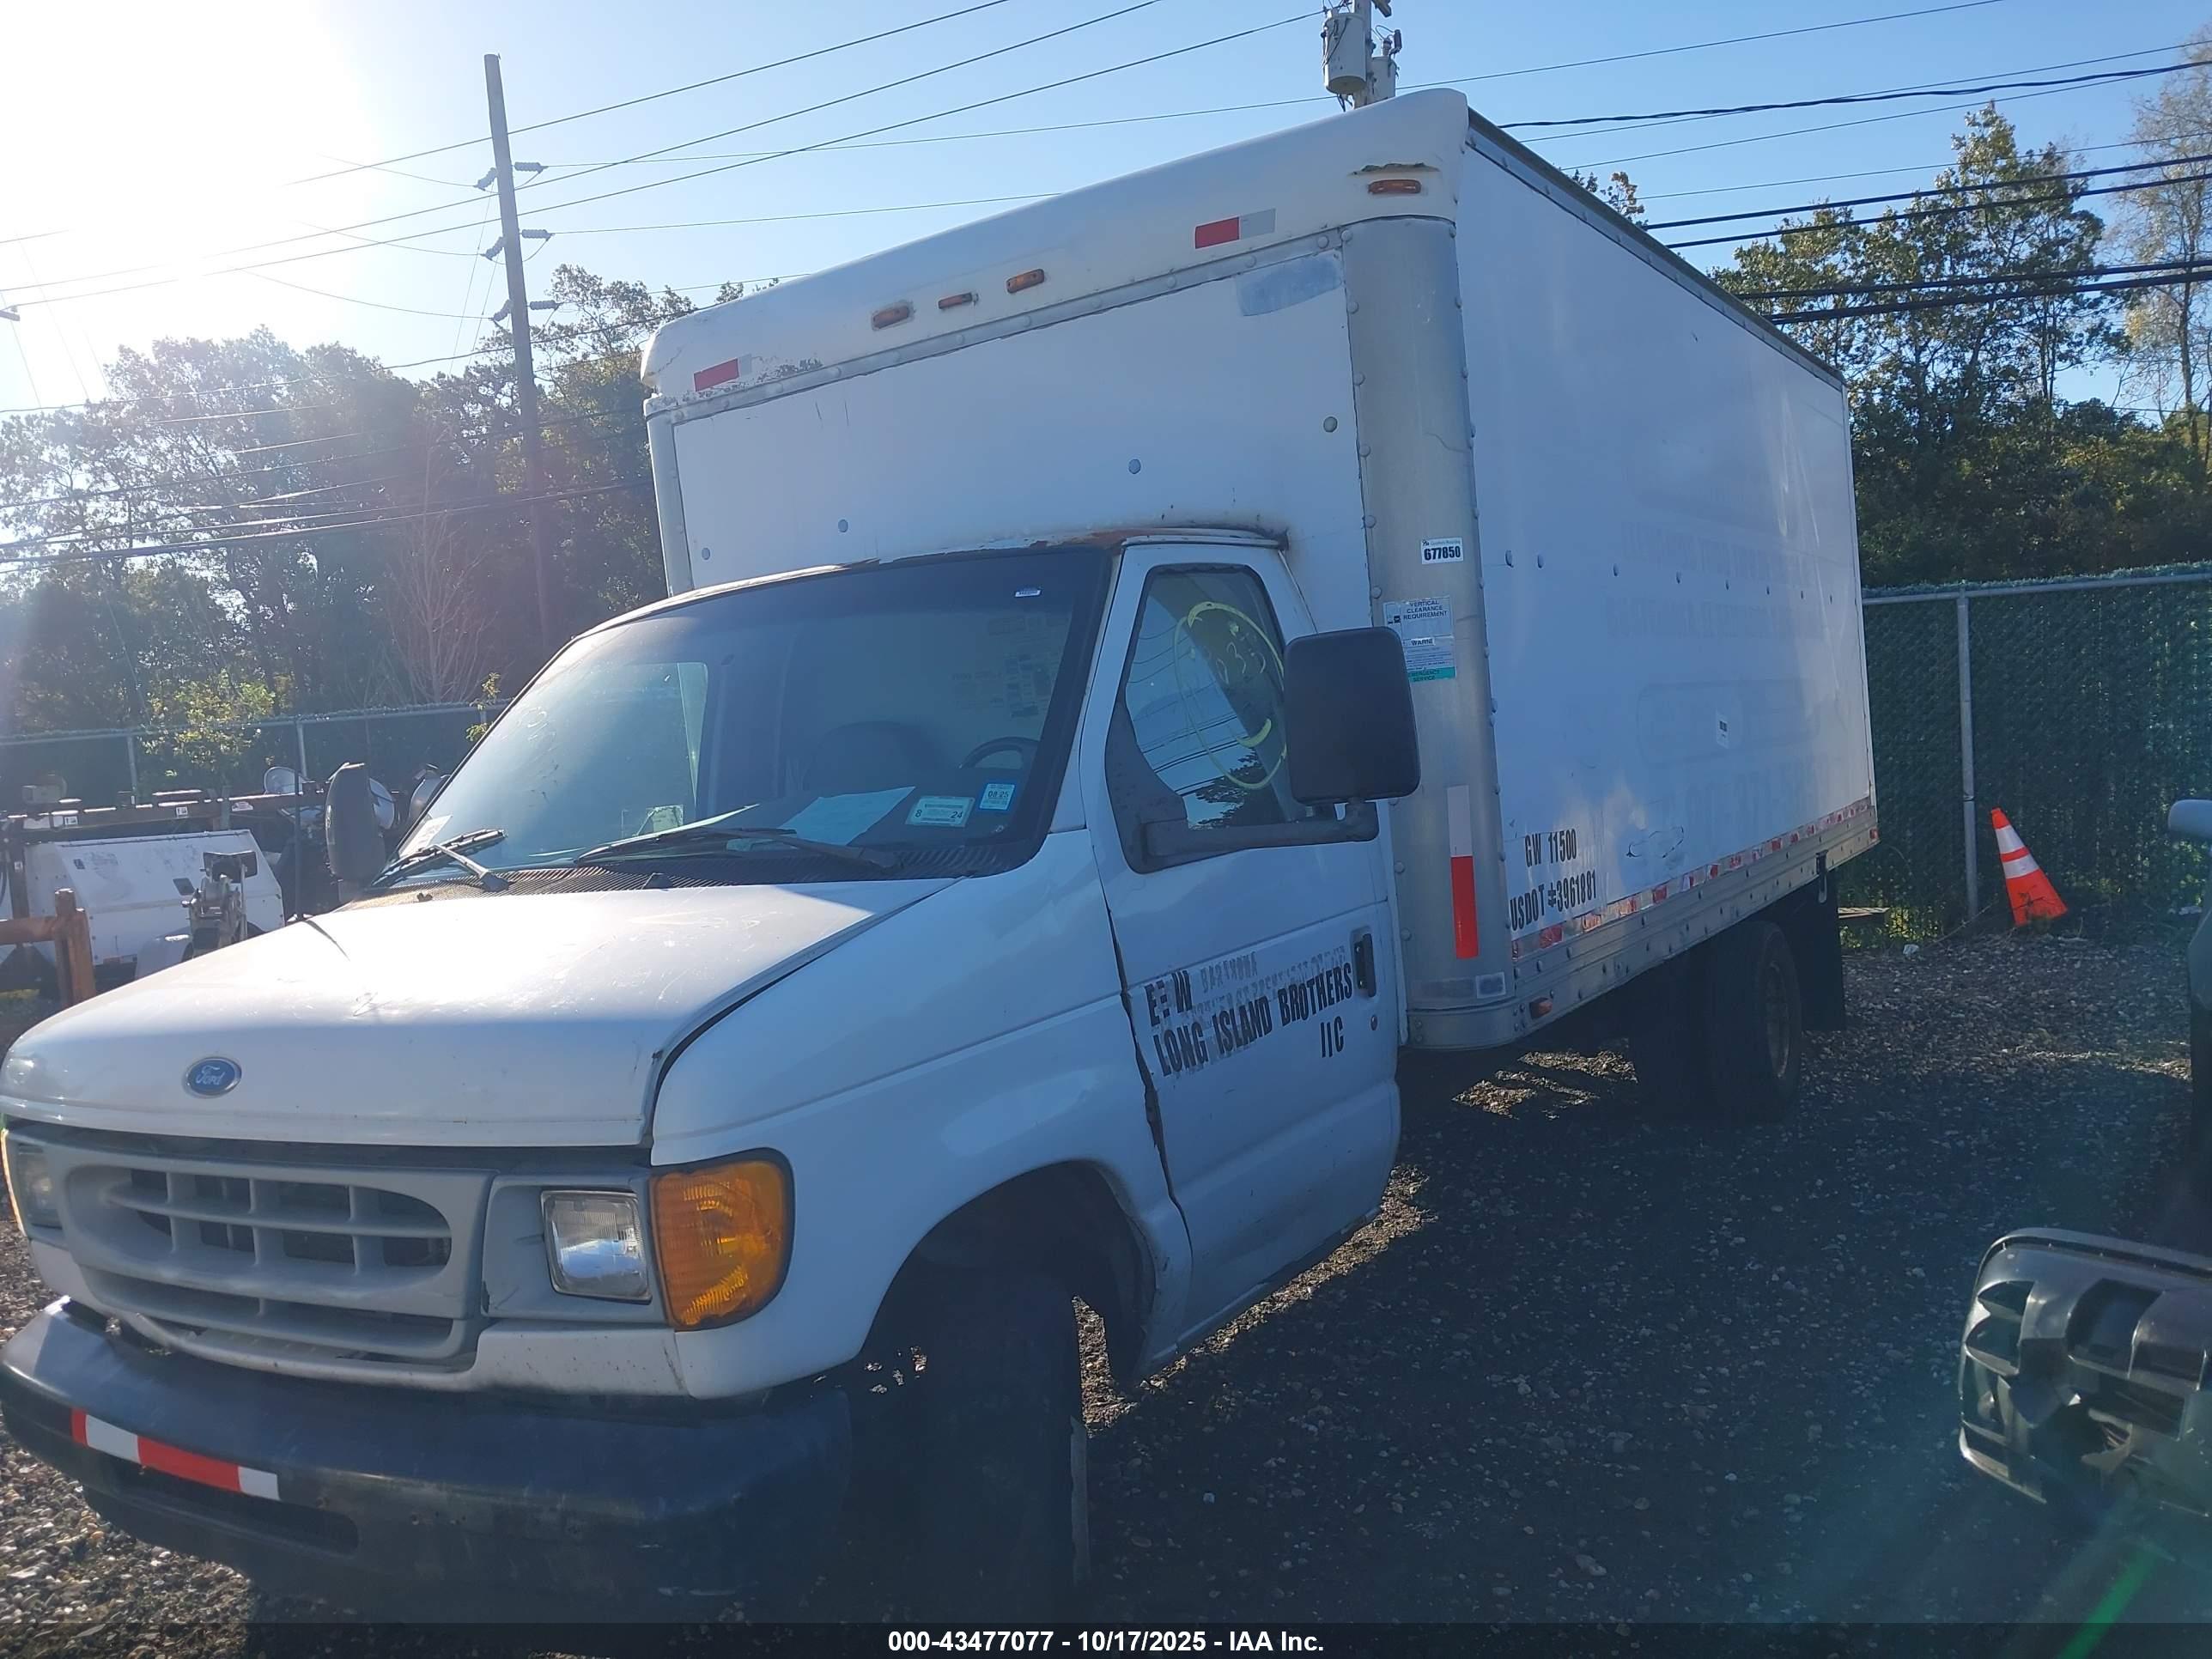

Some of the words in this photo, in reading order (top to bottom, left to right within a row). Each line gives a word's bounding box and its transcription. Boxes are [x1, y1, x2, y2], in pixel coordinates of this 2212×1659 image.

[1424, 545, 1461, 561] 677850
[1403, 611, 1448, 620] REQUIREMENT
[1407, 605, 1443, 613] CLEARANCE
[1524, 833, 1542, 867] GW
[1547, 829, 1577, 863] 11500
[1510, 884, 1545, 931] USDOT
[1547, 870, 1597, 913] #3961881
[1152, 1022, 1209, 1077] LONG
[1212, 995, 1273, 1055] ISLAND
[1277, 962, 1353, 1027] BROTHERS
